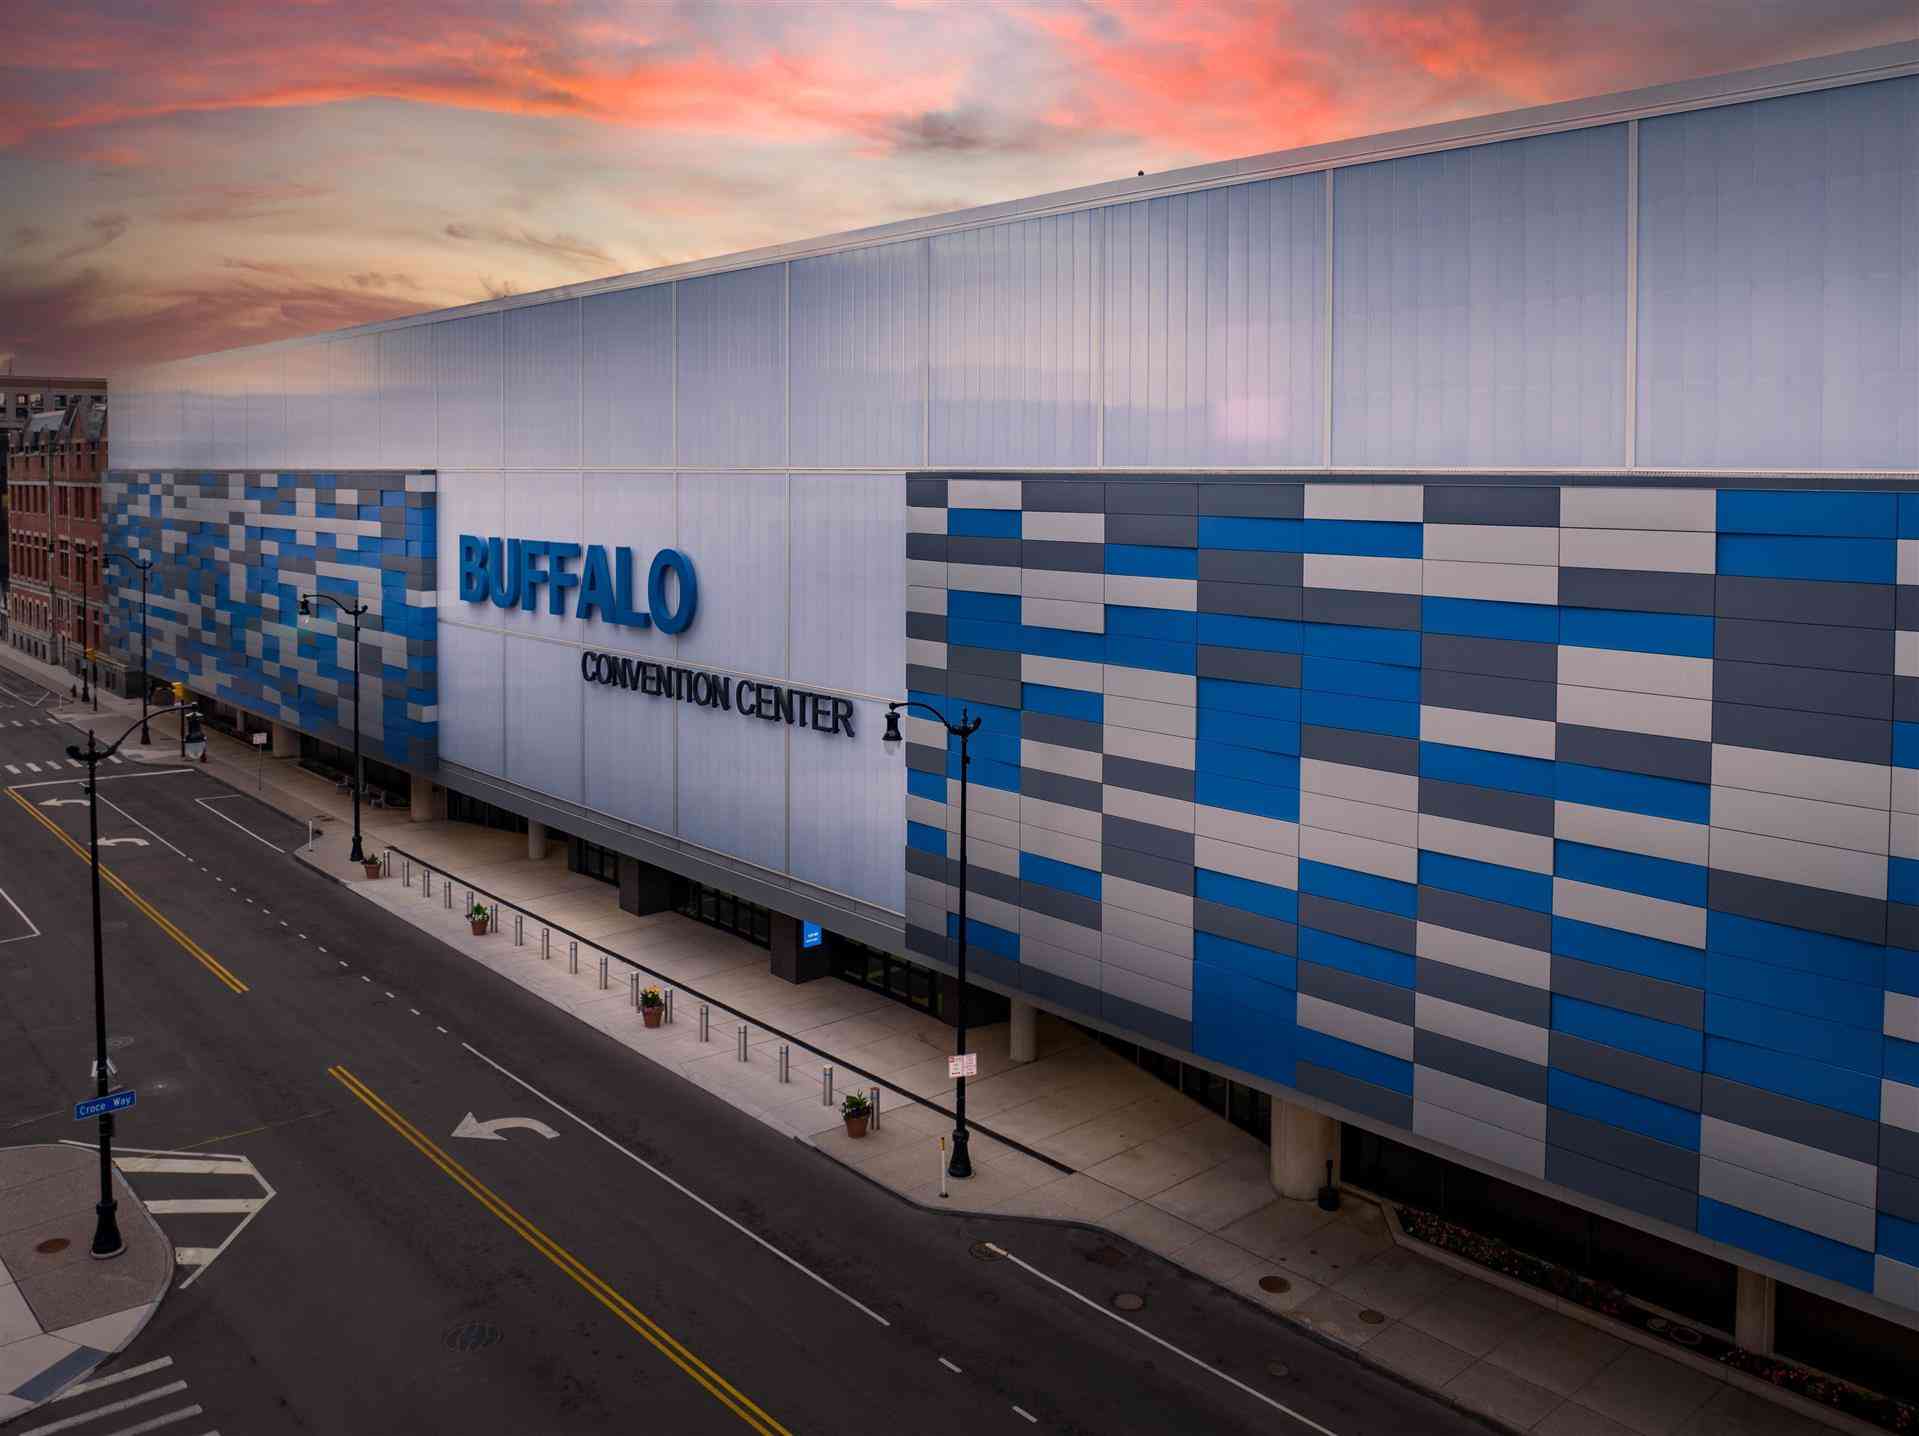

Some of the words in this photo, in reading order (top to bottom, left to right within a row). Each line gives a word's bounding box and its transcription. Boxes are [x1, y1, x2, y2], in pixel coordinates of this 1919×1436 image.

[459, 533, 699, 636] BUFFALO
[581, 650, 731, 711] CONVENTION
[735, 679, 856, 738] CENTER
[79, 1102, 106, 1116] Croce
[112, 1095, 132, 1106] Way
